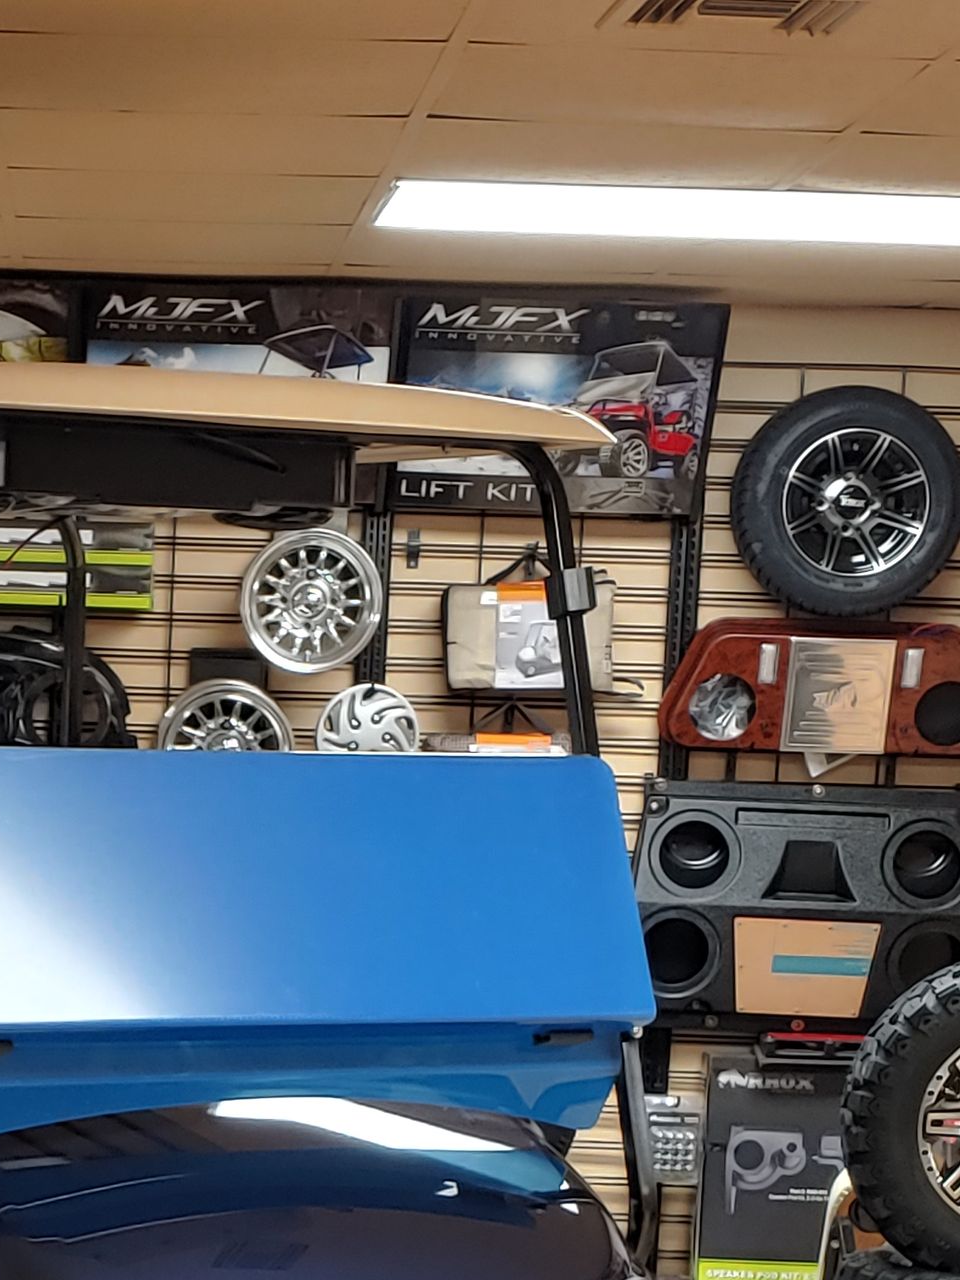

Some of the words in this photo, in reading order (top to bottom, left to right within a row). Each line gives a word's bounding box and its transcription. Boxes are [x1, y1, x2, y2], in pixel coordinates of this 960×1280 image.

[415, 331, 581, 344] INNOVATIVE
[400, 479, 474, 500] LIFT
[747, 1071, 815, 1090] RHOX
